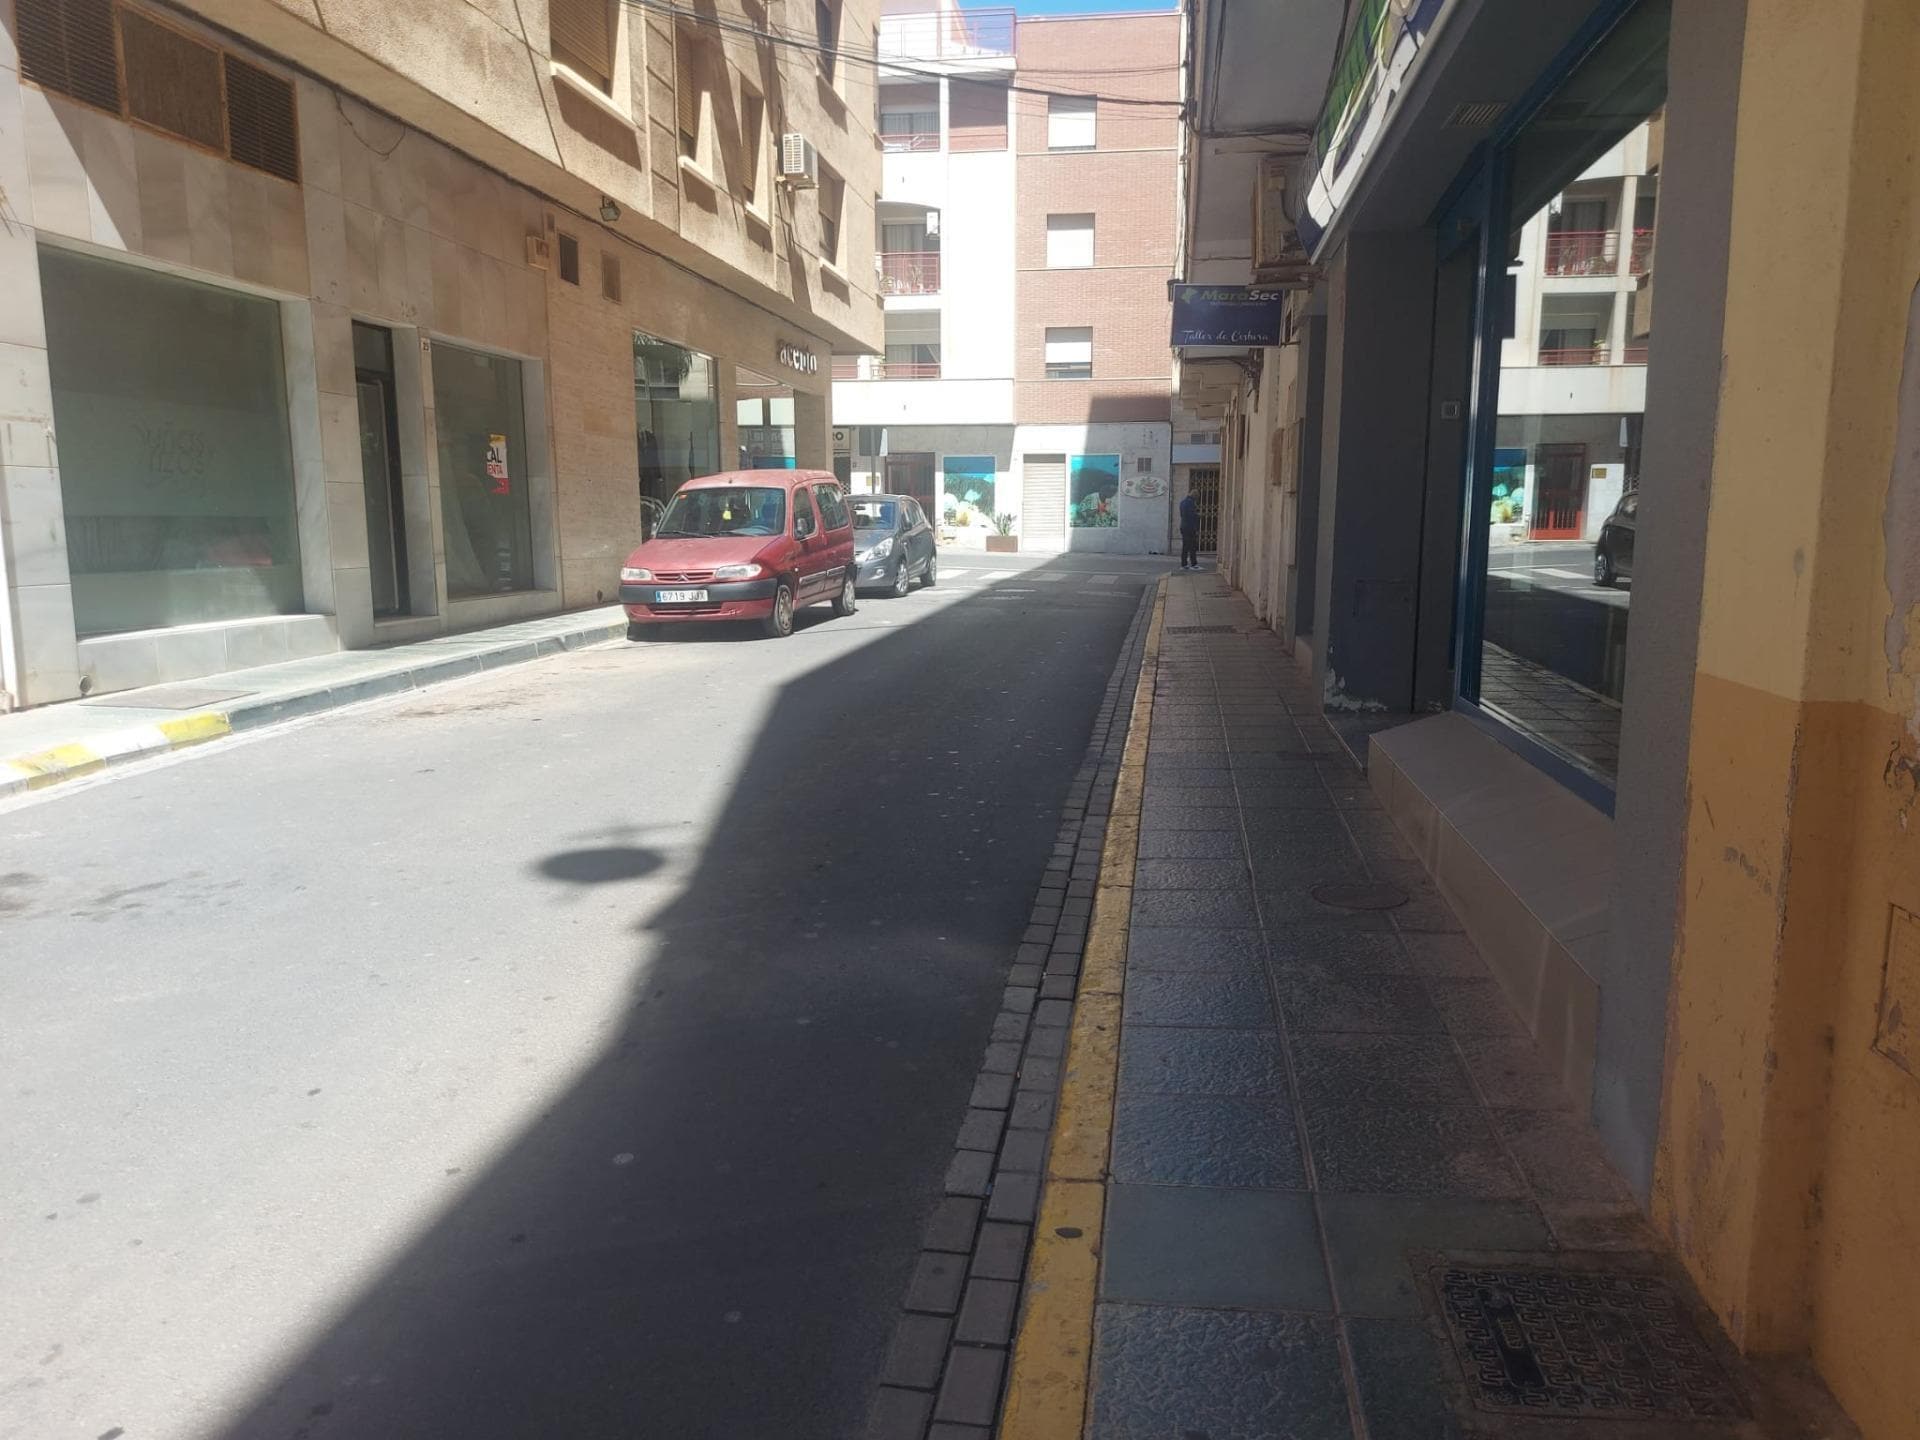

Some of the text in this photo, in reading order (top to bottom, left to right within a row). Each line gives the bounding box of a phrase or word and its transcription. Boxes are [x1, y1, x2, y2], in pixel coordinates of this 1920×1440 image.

[1183, 330, 1212, 343] Taller
[1216, 330, 1228, 341] de
[662, 592, 685, 601] 6719
